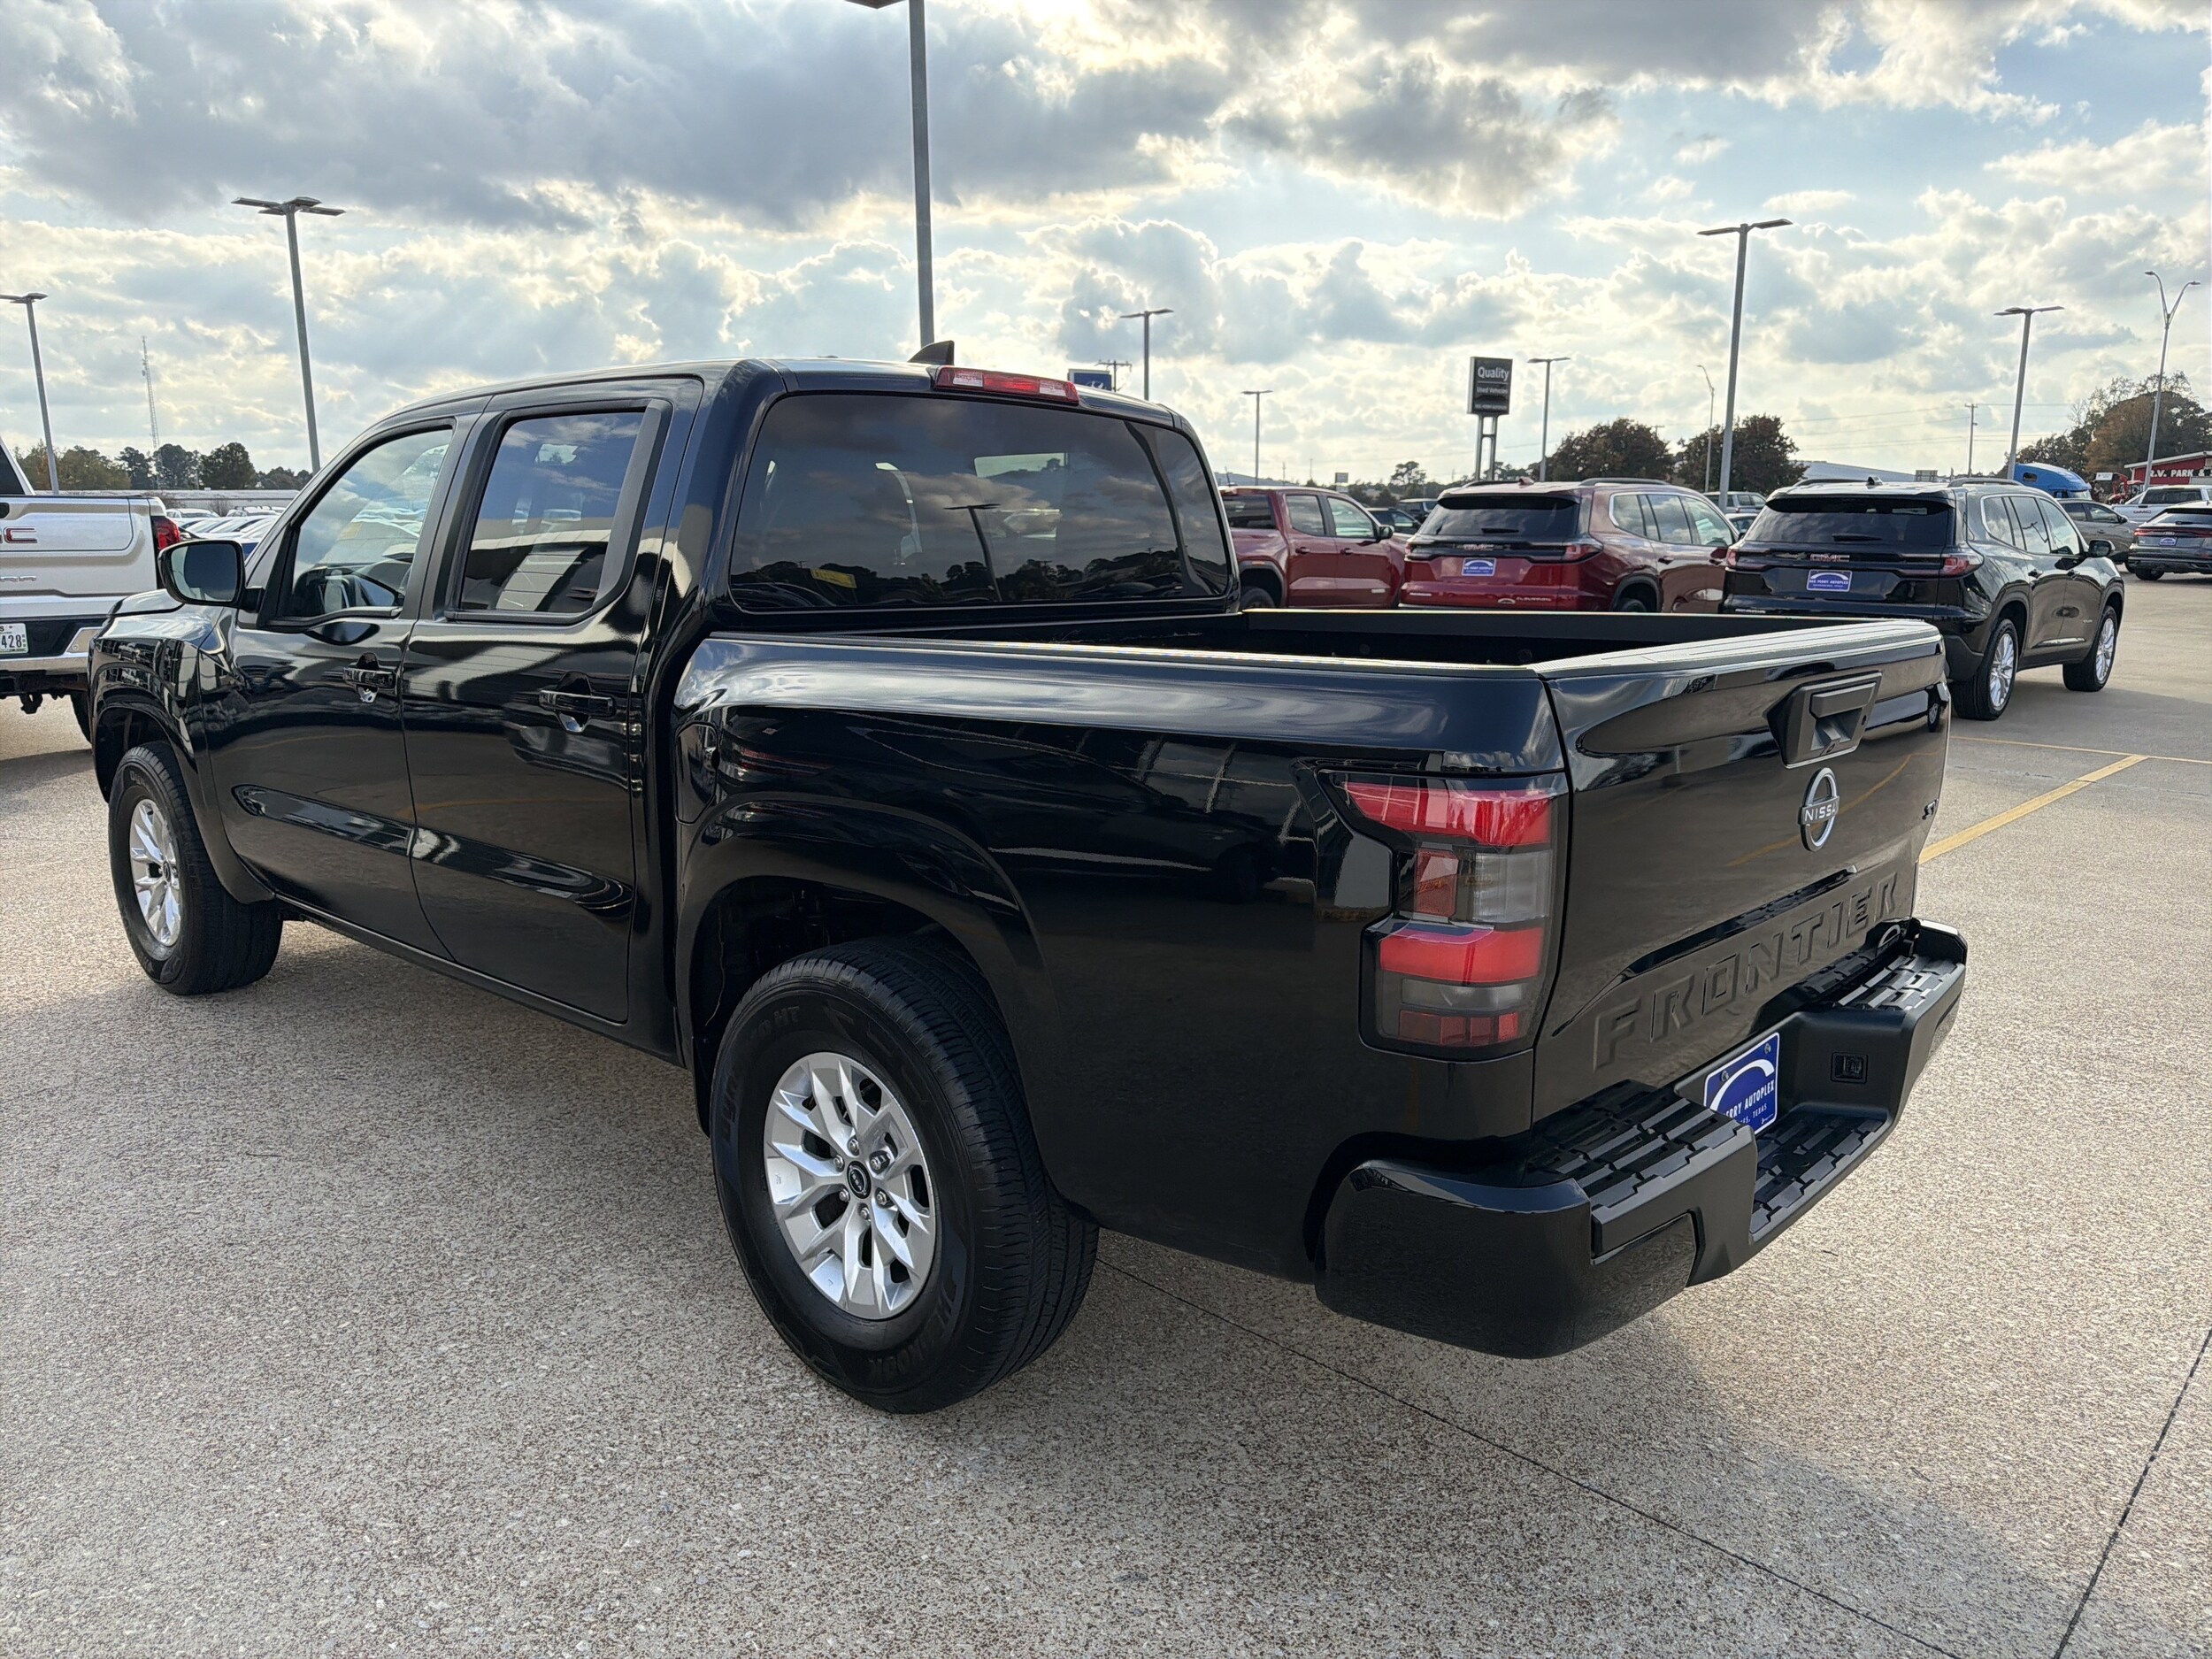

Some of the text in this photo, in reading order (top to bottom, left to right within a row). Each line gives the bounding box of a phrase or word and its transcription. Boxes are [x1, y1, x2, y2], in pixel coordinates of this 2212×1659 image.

[1477, 366, 1509, 381] Quality
[1809, 553, 1850, 563] GMC
[1, 634, 22, 649] 428
[1593, 872, 1898, 1073] FRONTIER
[1724, 1079, 1774, 1118] ERRY AUTOPLEX
[1752, 1102, 1767, 1118] TEXAS
